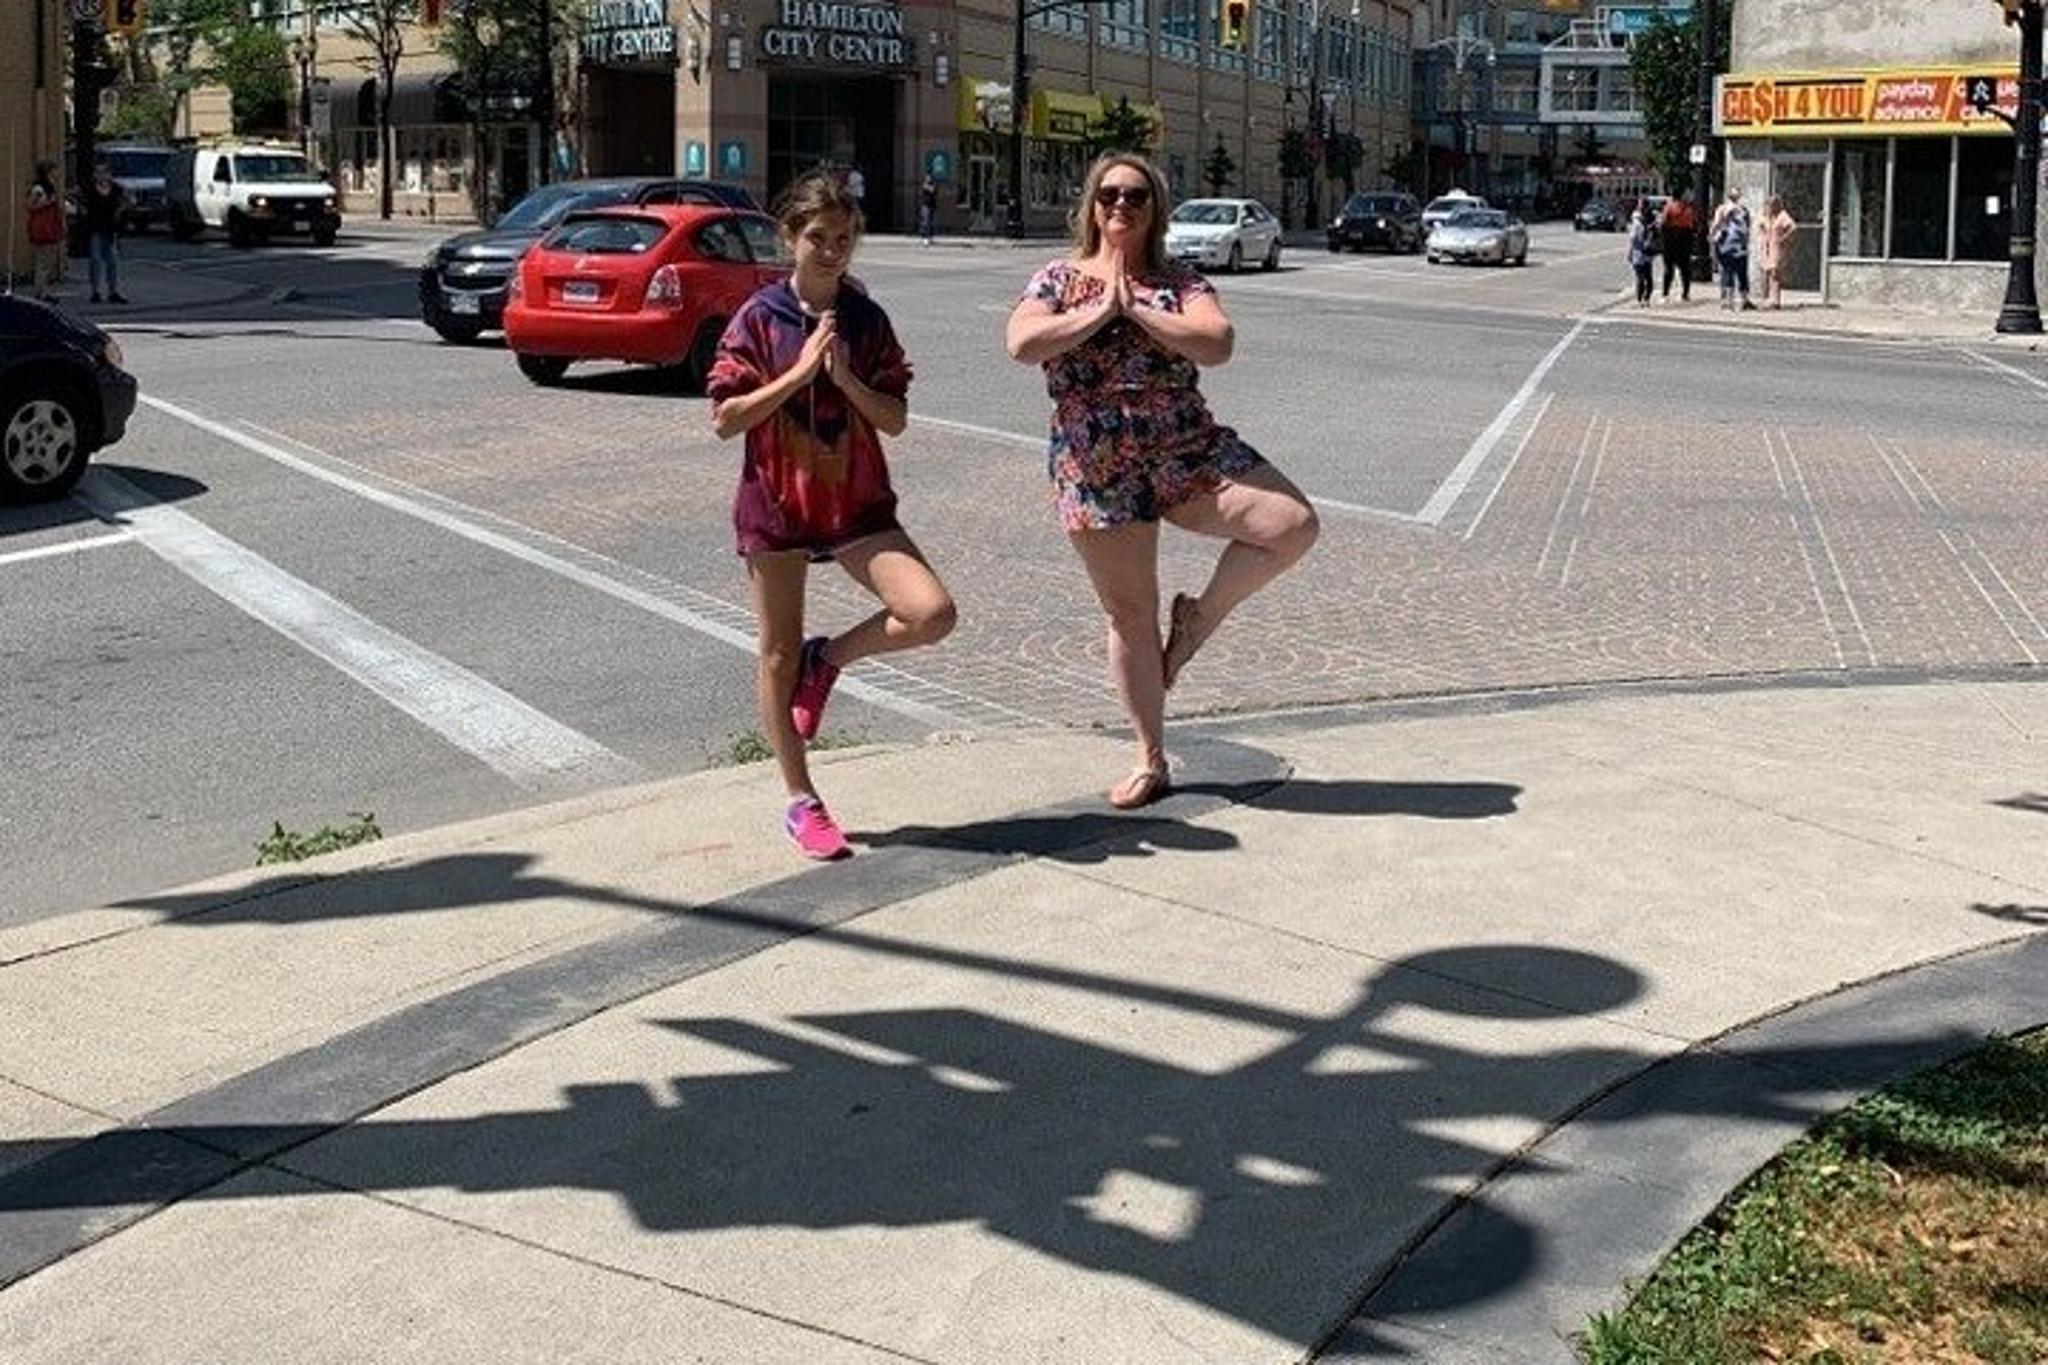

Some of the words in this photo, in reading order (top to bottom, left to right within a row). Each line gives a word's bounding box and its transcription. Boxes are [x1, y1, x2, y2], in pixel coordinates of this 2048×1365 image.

[781, 0, 904, 35] HAMILTON
[611, 26, 673, 56] CENTRE
[764, 26, 820, 57] CITY
[1723, 79, 1790, 127] CA$H
[1794, 87, 1811, 117] 4
[1816, 86, 1865, 118] YOU
[1876, 79, 1938, 102] payday
[1874, 103, 1943, 121] advance
